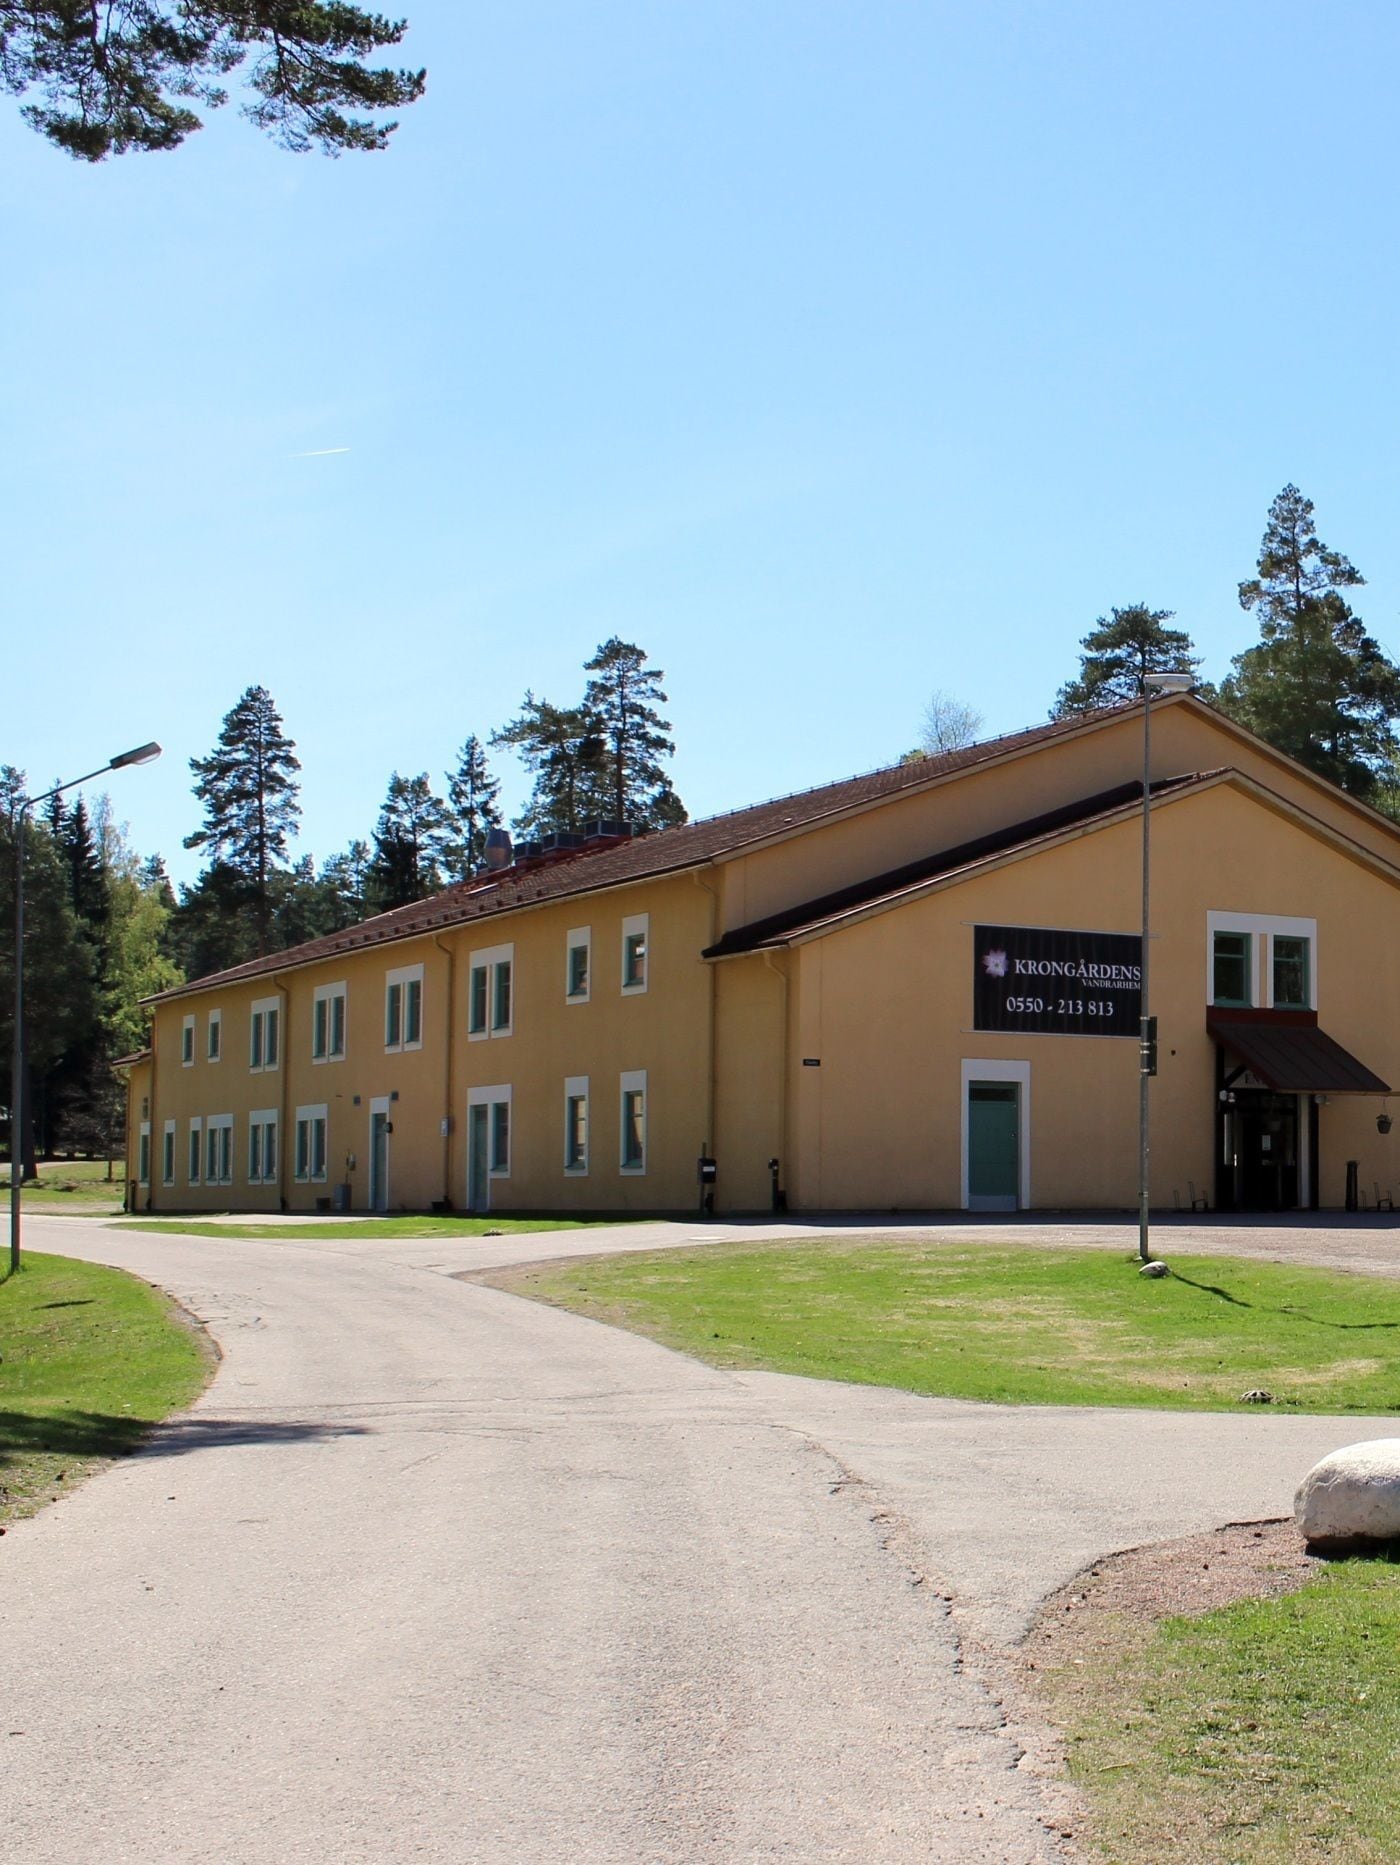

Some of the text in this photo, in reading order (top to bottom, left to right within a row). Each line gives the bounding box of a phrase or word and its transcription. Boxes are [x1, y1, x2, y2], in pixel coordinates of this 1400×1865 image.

[1013, 959, 1142, 981] KRONGÅRDENS
[1081, 978, 1142, 990] VANDRARHEM
[1006, 996, 1043, 1013] 0550
[1057, 999, 1083, 1015] 213
[1088, 1000, 1114, 1016] 813
